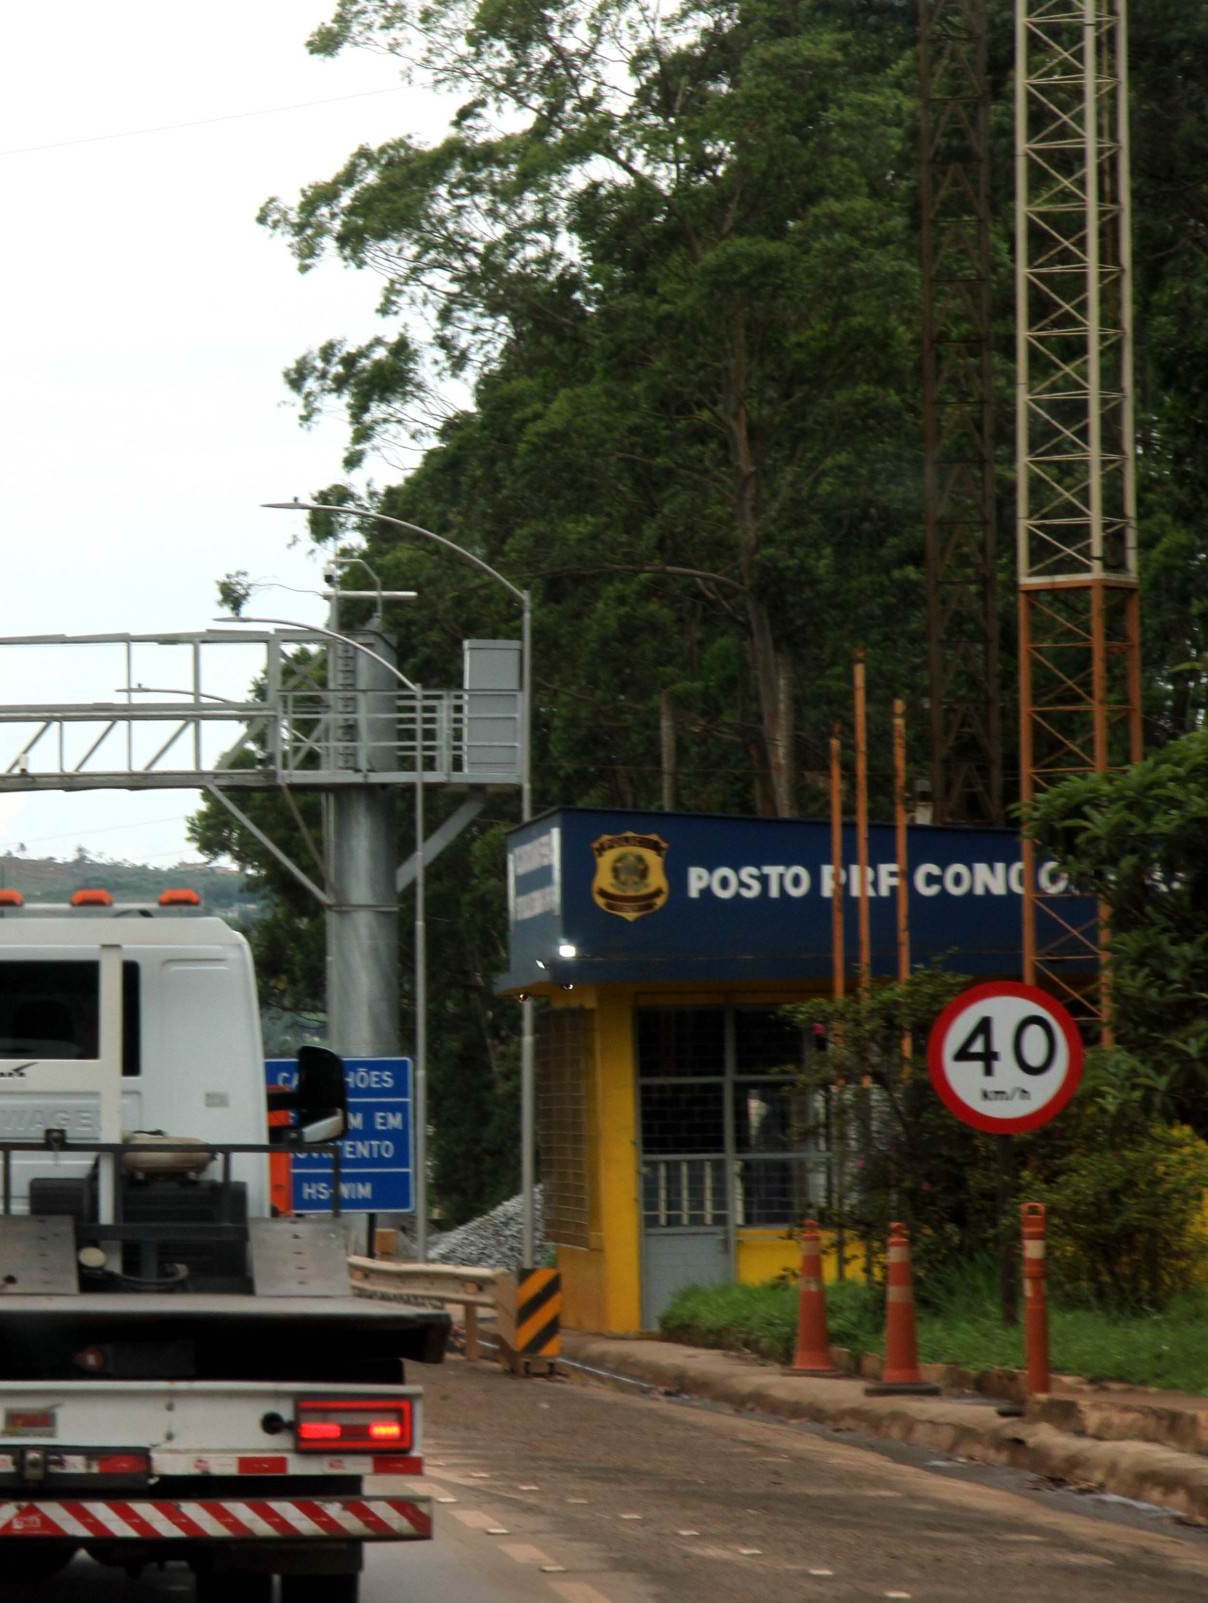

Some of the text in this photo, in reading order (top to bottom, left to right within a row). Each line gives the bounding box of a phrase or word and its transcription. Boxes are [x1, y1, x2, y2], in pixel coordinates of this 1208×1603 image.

[687, 865, 812, 899] POSTO
[952, 1014, 1057, 1077] 40
[374, 1112, 403, 1131] EM
